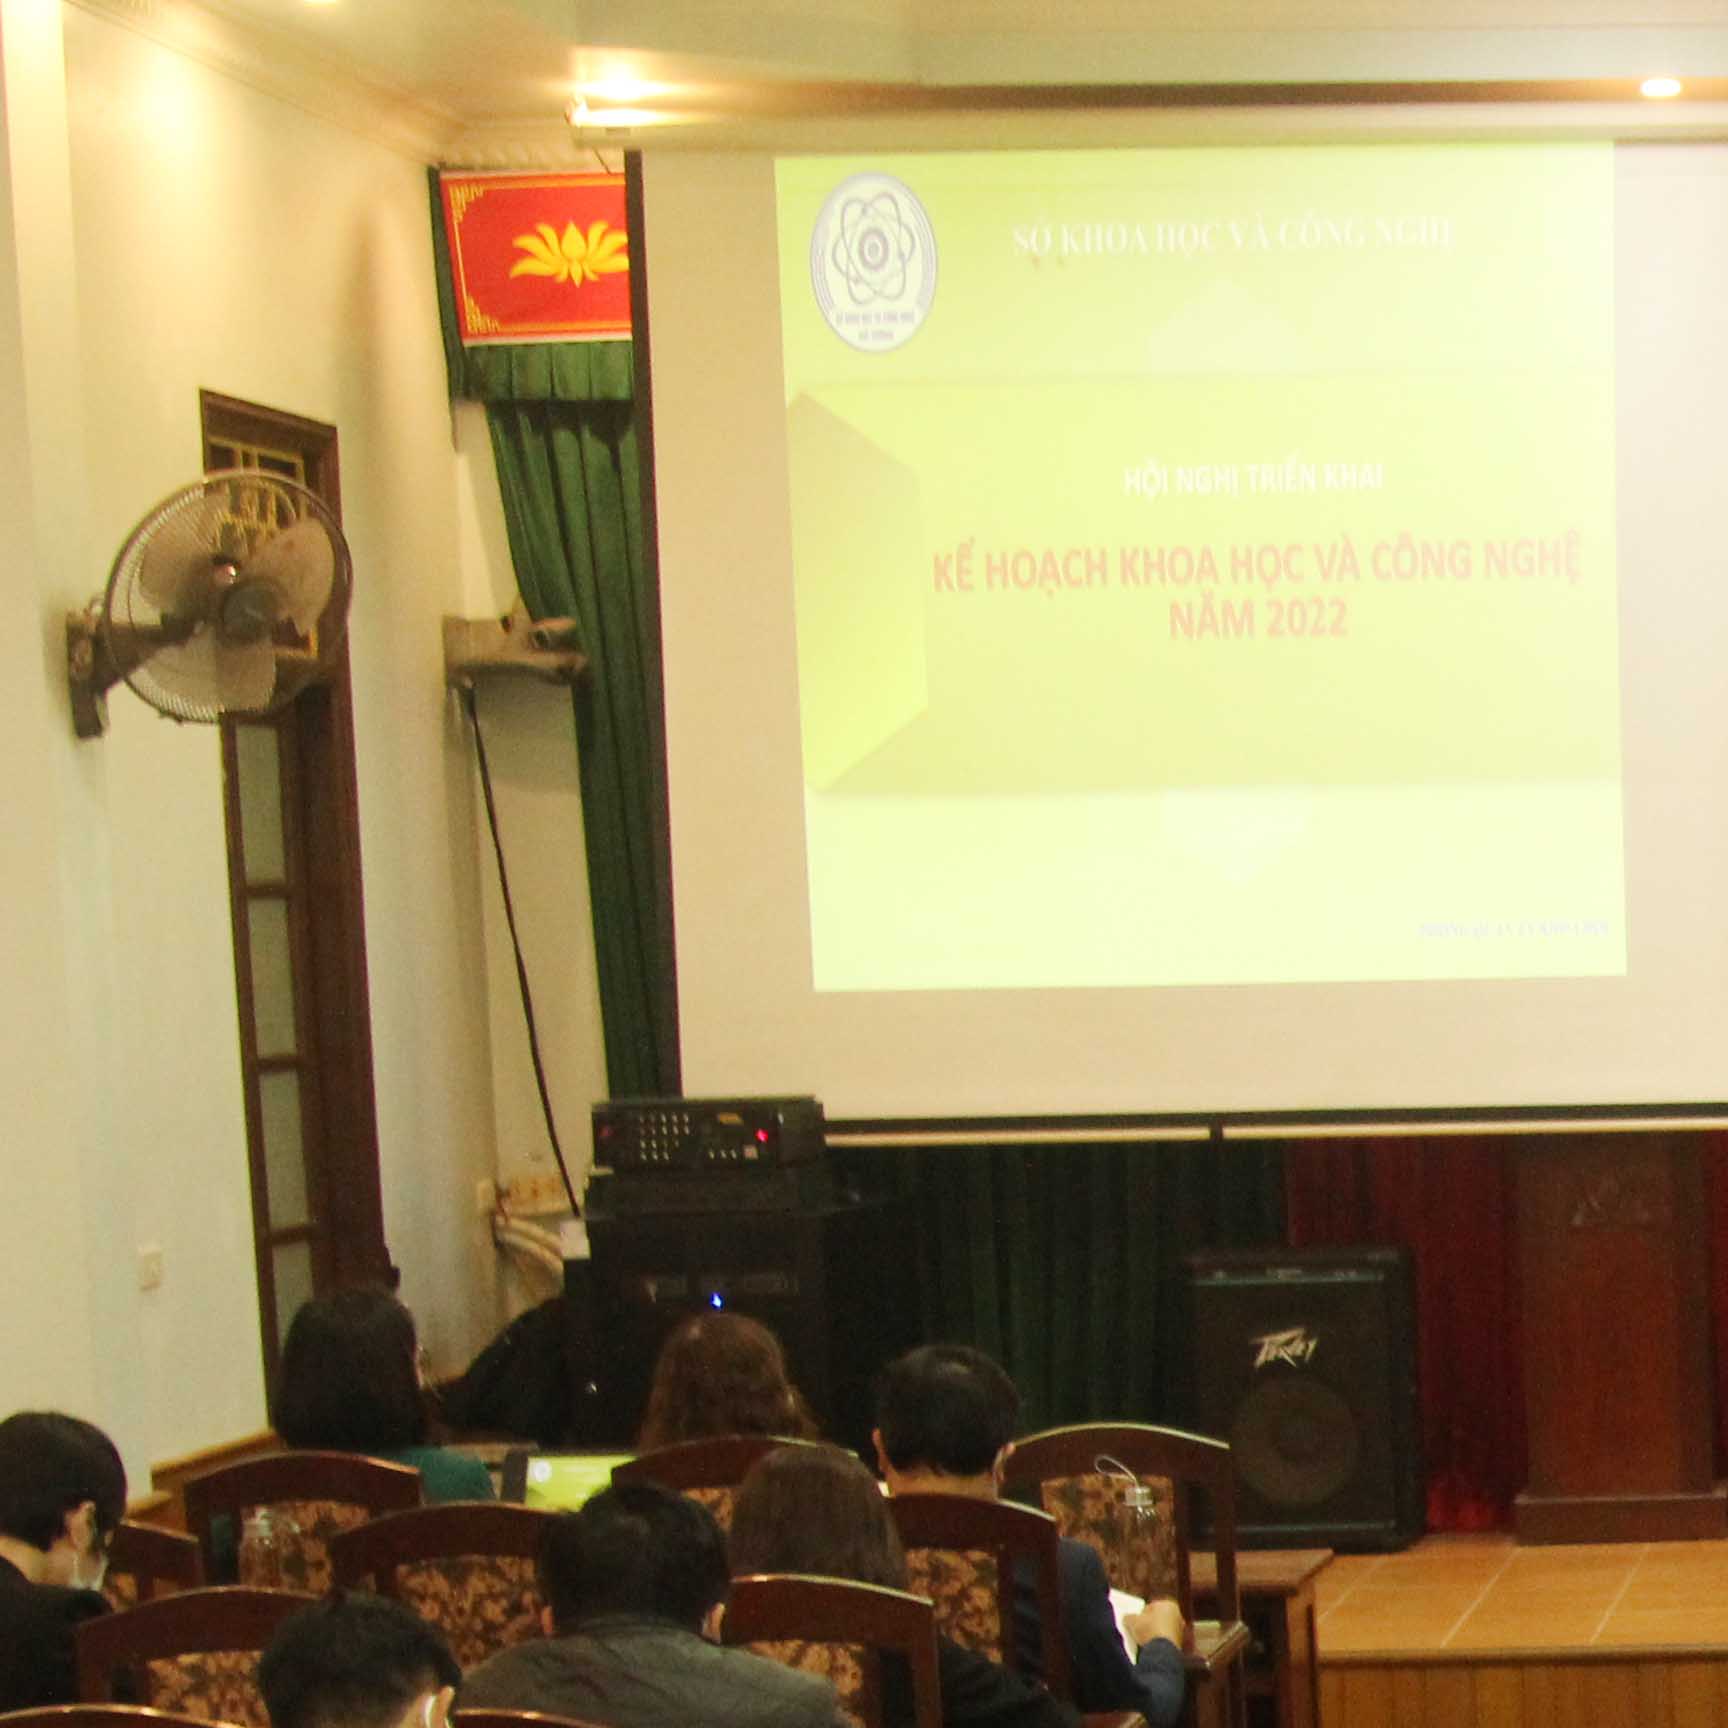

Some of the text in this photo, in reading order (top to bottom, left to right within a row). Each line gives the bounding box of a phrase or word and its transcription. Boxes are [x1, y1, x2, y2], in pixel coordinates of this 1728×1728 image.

[1062, 220, 1149, 257] KHOA
[1123, 459, 1168, 502] HỘI
[1176, 463, 1240, 499] NGHỊ
[1323, 461, 1384, 490] KHAI
[933, 529, 1583, 600] KẾ HOẠCH KHOA HỌC VÀ CÔNG NGHỆ
[1168, 590, 1349, 641] NĂM 2022
